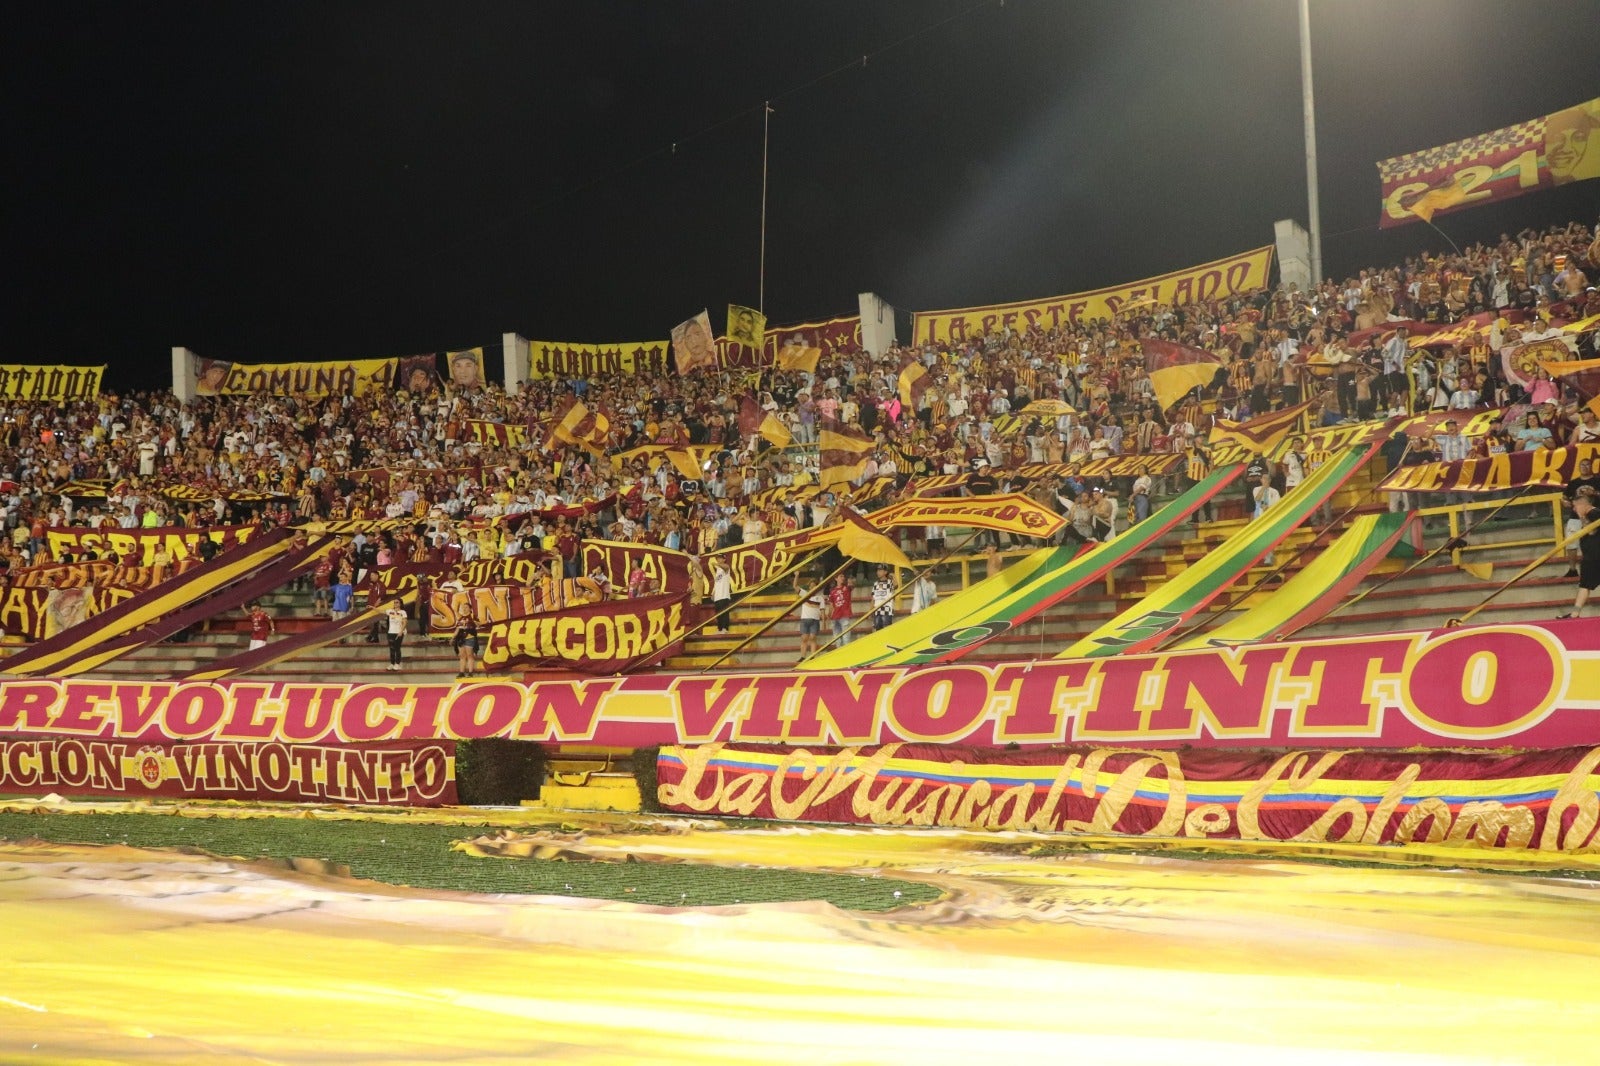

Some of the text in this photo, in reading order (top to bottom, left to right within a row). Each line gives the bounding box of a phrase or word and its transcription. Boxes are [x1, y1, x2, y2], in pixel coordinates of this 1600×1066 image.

[929, 316, 971, 345] LA
[430, 587, 511, 629] SAN
[483, 601, 686, 664] CHICORAL
[0, 624, 1568, 745] REVOLUCION VINOTINTO
[171, 742, 448, 803] VINOTINTO
[658, 743, 769, 815] La
